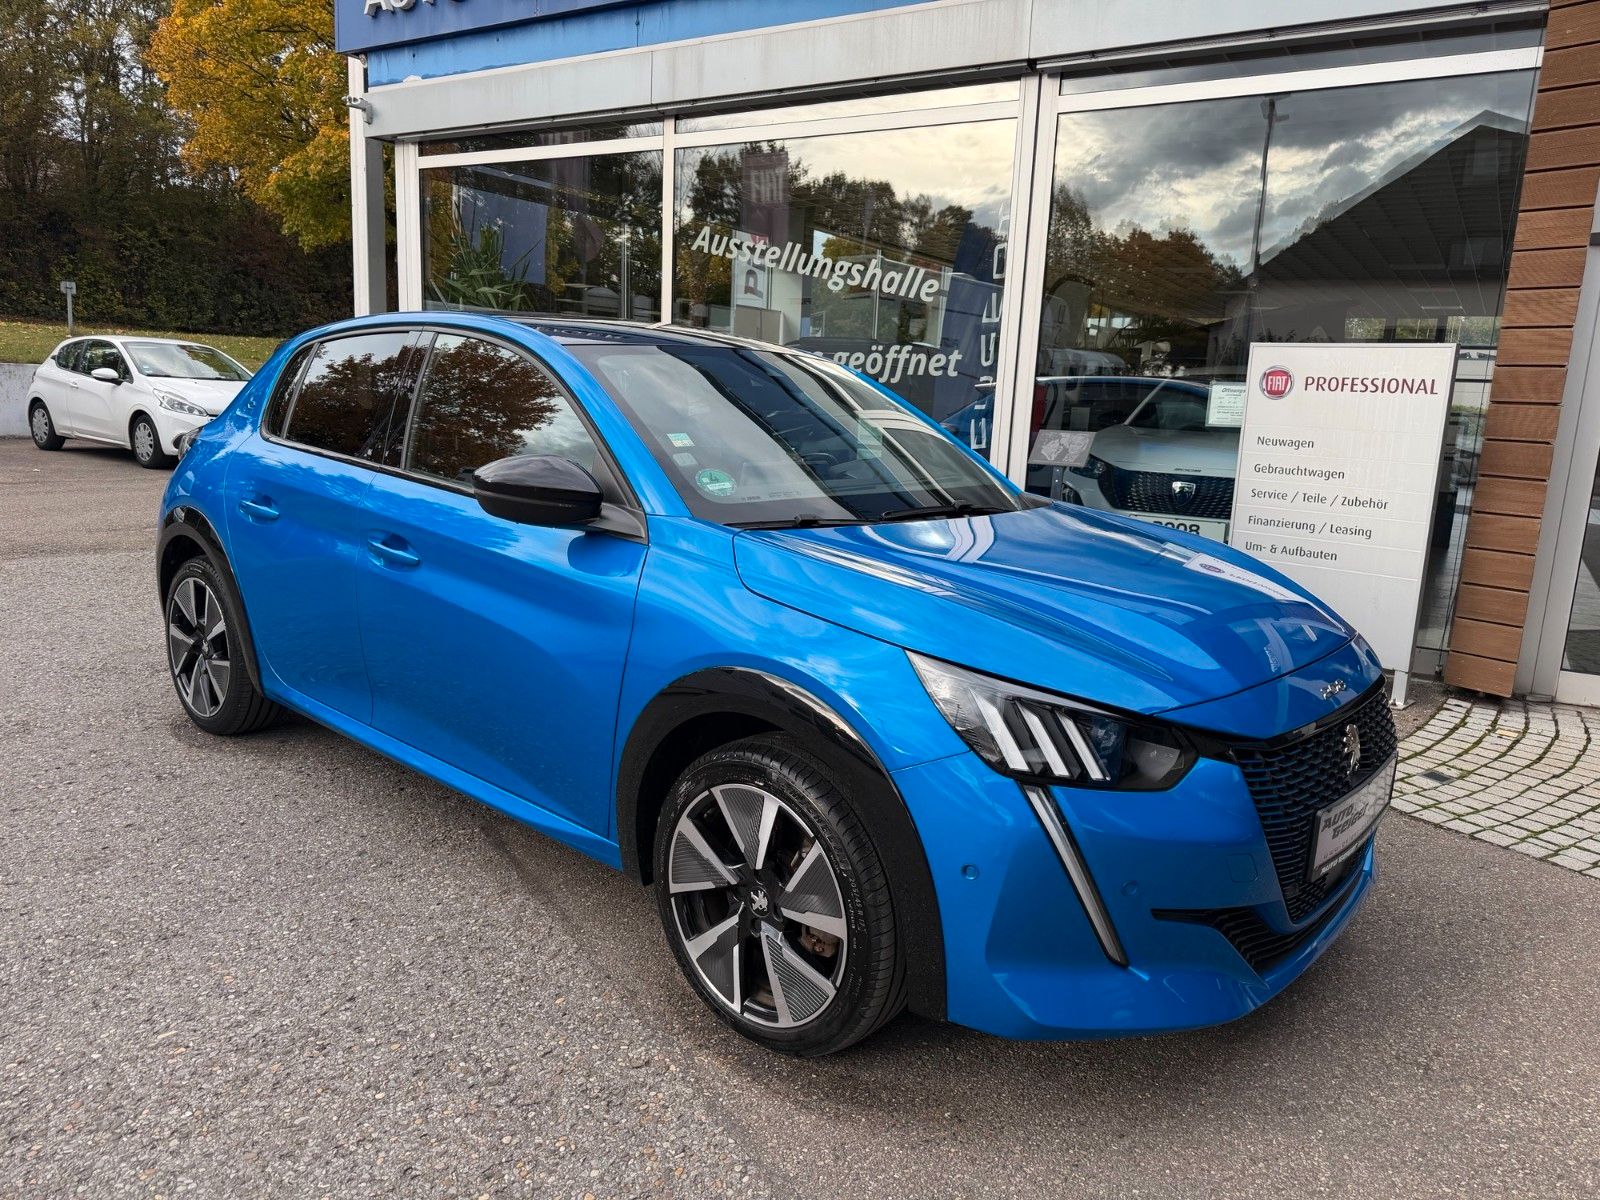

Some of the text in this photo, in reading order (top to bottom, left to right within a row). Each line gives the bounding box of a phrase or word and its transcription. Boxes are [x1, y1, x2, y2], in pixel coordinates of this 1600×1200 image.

[691, 225, 940, 301] Ausstellungshalle
[1267, 374, 1288, 392] FIAT
[1304, 376, 1439, 395] PROFESSIONAL
[1257, 436, 1315, 450] Neuwagen
[1254, 463, 1345, 481] Gebrauchtwagen
[1251, 488, 1389, 510] Service / Teile / Zubehör
[1153, 520, 1200, 535] 08
[1248, 515, 1372, 540] Finanzierung / Leasing
[1245, 541, 1338, 561] Um- & Aufbauten
